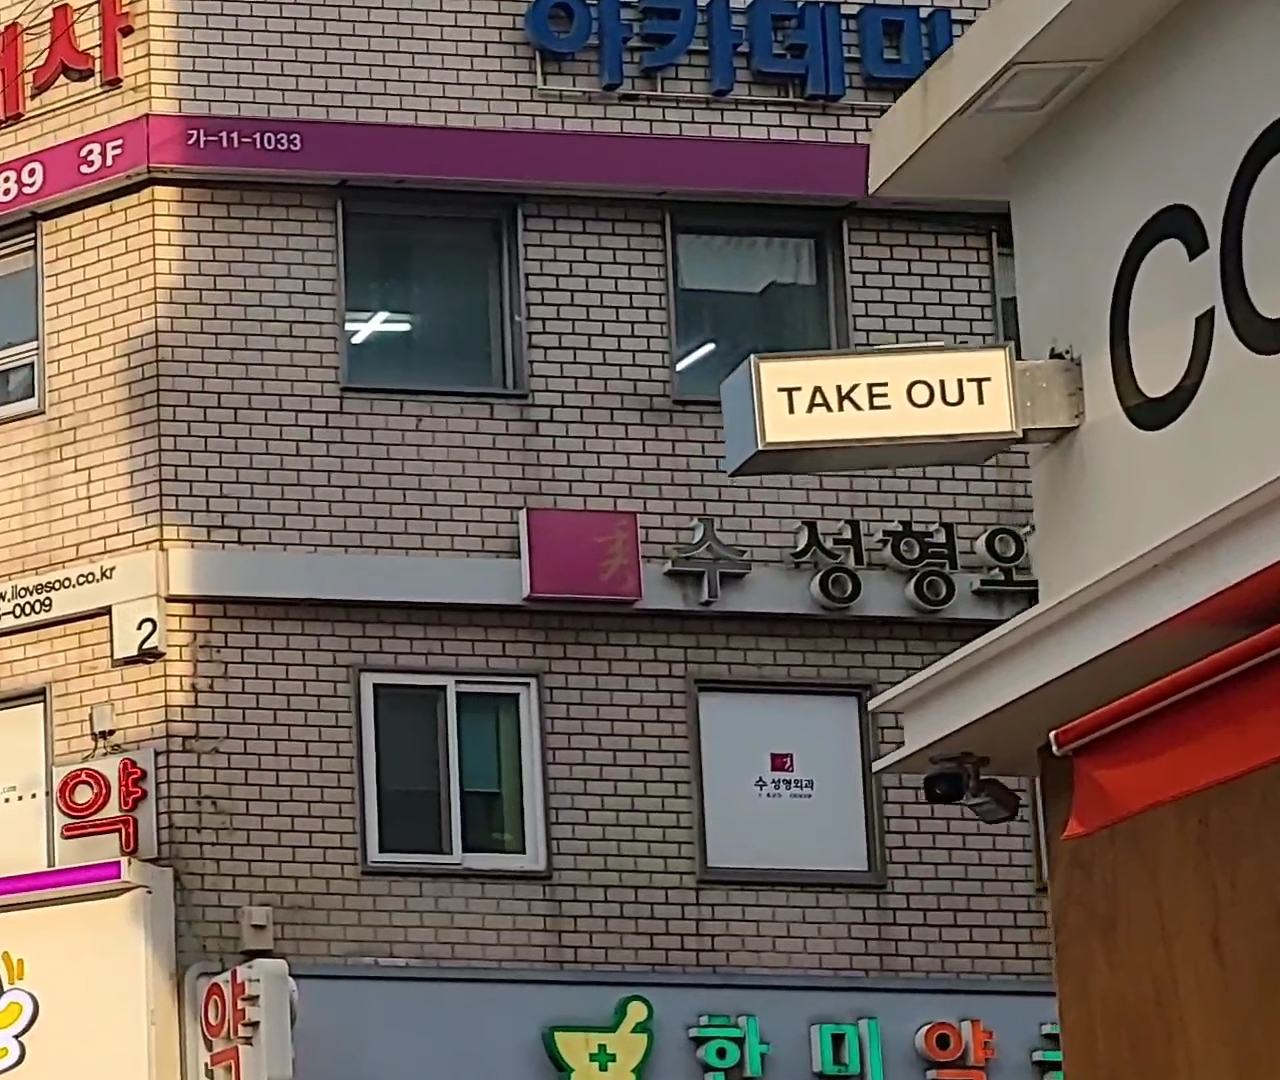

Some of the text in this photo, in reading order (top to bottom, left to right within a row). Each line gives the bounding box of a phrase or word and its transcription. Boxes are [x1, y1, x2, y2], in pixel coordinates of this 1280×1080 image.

[525, 0, 953, 101] 아카데미
[78, 138, 124, 175] 3F
[186, 128, 302, 153] 가-11-1033
[778, 377, 992, 415] TAKE OUT
[663, 518, 752, 605] 수
[135, 617, 159, 652] 2
[754, 776, 768, 791] 수
[56, 756, 148, 855] 약
